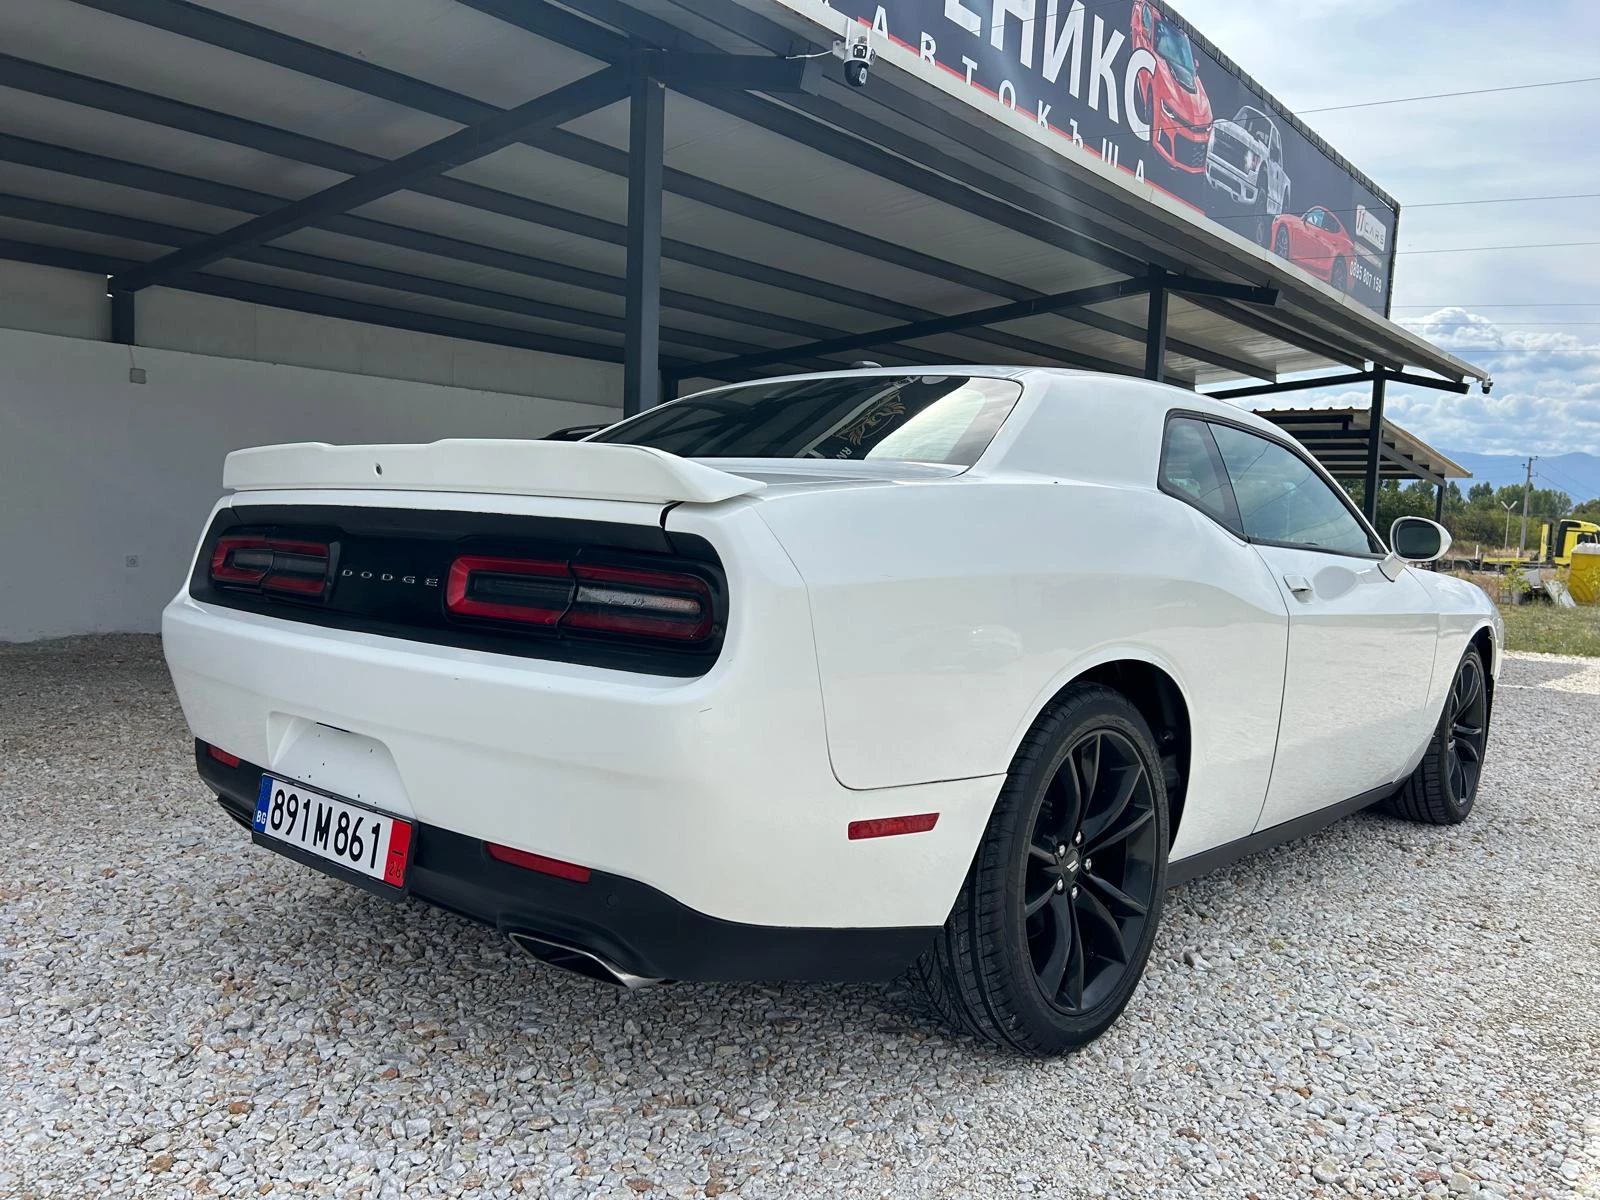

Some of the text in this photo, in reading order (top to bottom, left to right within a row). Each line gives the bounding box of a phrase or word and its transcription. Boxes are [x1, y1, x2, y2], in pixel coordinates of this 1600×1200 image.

[944, 0, 1157, 141] НИКС
[342, 569, 439, 587] DODGE
[256, 789, 381, 869] BG 891M861
[388, 861, 402, 879] 26
